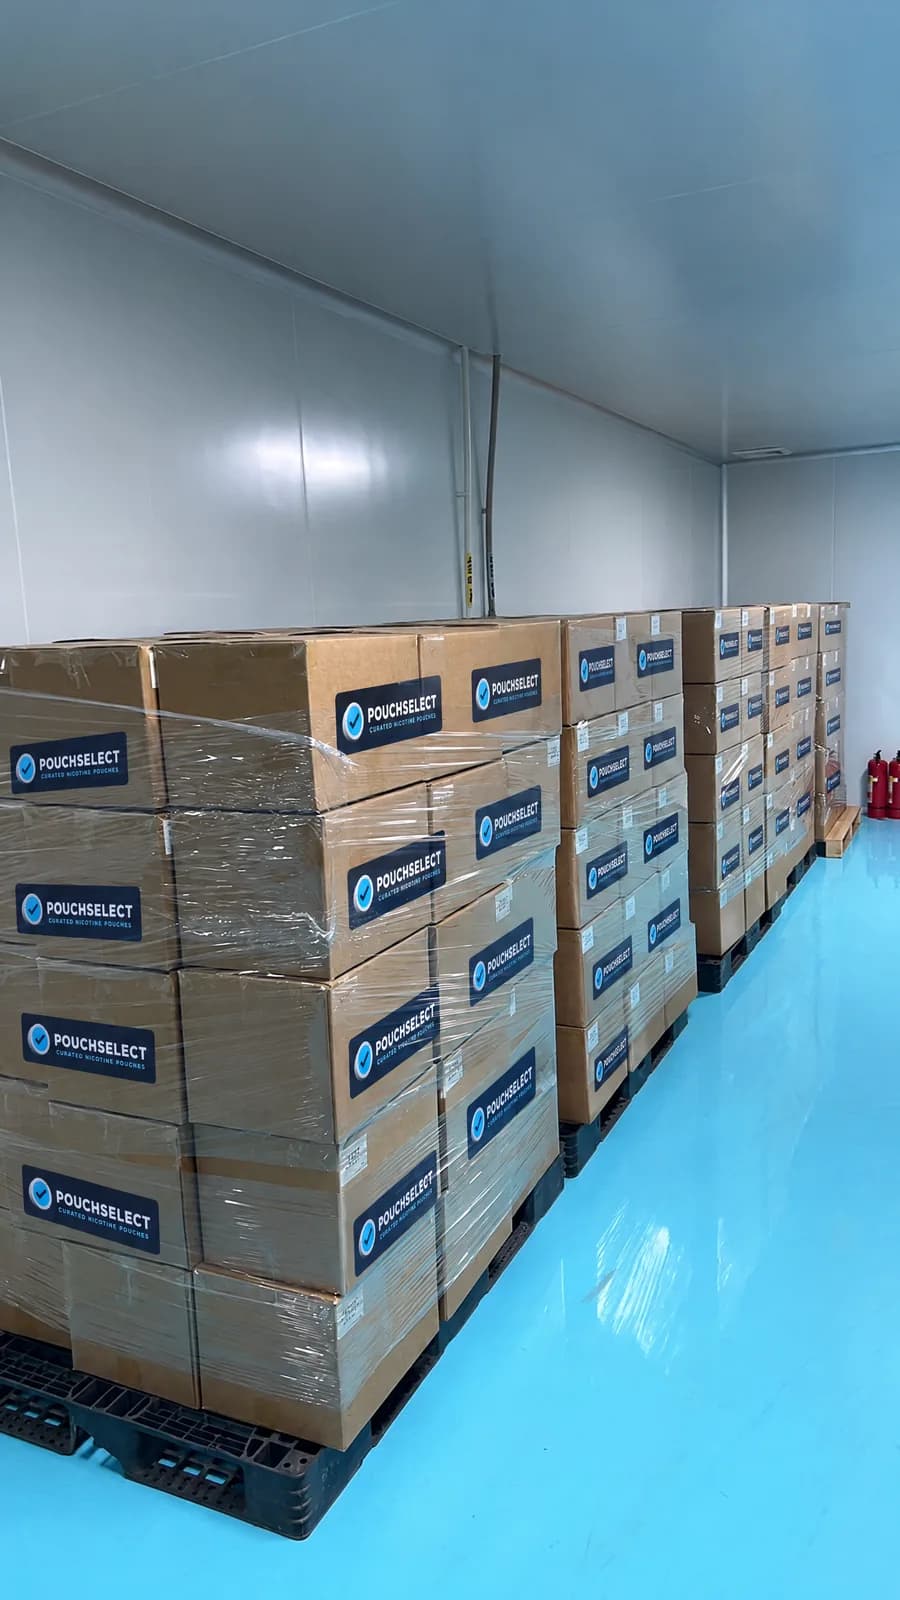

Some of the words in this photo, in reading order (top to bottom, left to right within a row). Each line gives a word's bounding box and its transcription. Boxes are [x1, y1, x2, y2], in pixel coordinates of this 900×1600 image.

[492, 674, 538, 696] POUCHSELECT
[368, 694, 437, 723] POUCHSELECT
[369, 723, 392, 733] CURATED
[394, 717, 415, 728] NICOTINE
[417, 712, 436, 722] POUCHES
[40, 750, 120, 770] POUCHSELECT
[495, 801, 538, 831] POUCHSELECT
[377, 851, 441, 892] POUCHSELECT
[47, 902, 132, 918] POUCHSELECT
[488, 934, 530, 974] POUCHSELECT
[376, 1003, 435, 1056] POUCHSELECT
[54, 1033, 147, 1060] POUCHSELECT
[56, 1050, 83, 1059] CURATED
[85, 1054, 113, 1065] NICOTINE
[116, 1060, 145, 1070] POUCHES
[486, 1066, 532, 1120] POUCHSELECT
[56, 1190, 150, 1230] POUCHSELECT
[378, 1170, 432, 1231] POUCHSELECT
[58, 1206, 85, 1220] CURATED
[88, 1215, 116, 1230] NICOTINE
[119, 1225, 149, 1240] POUCHES
